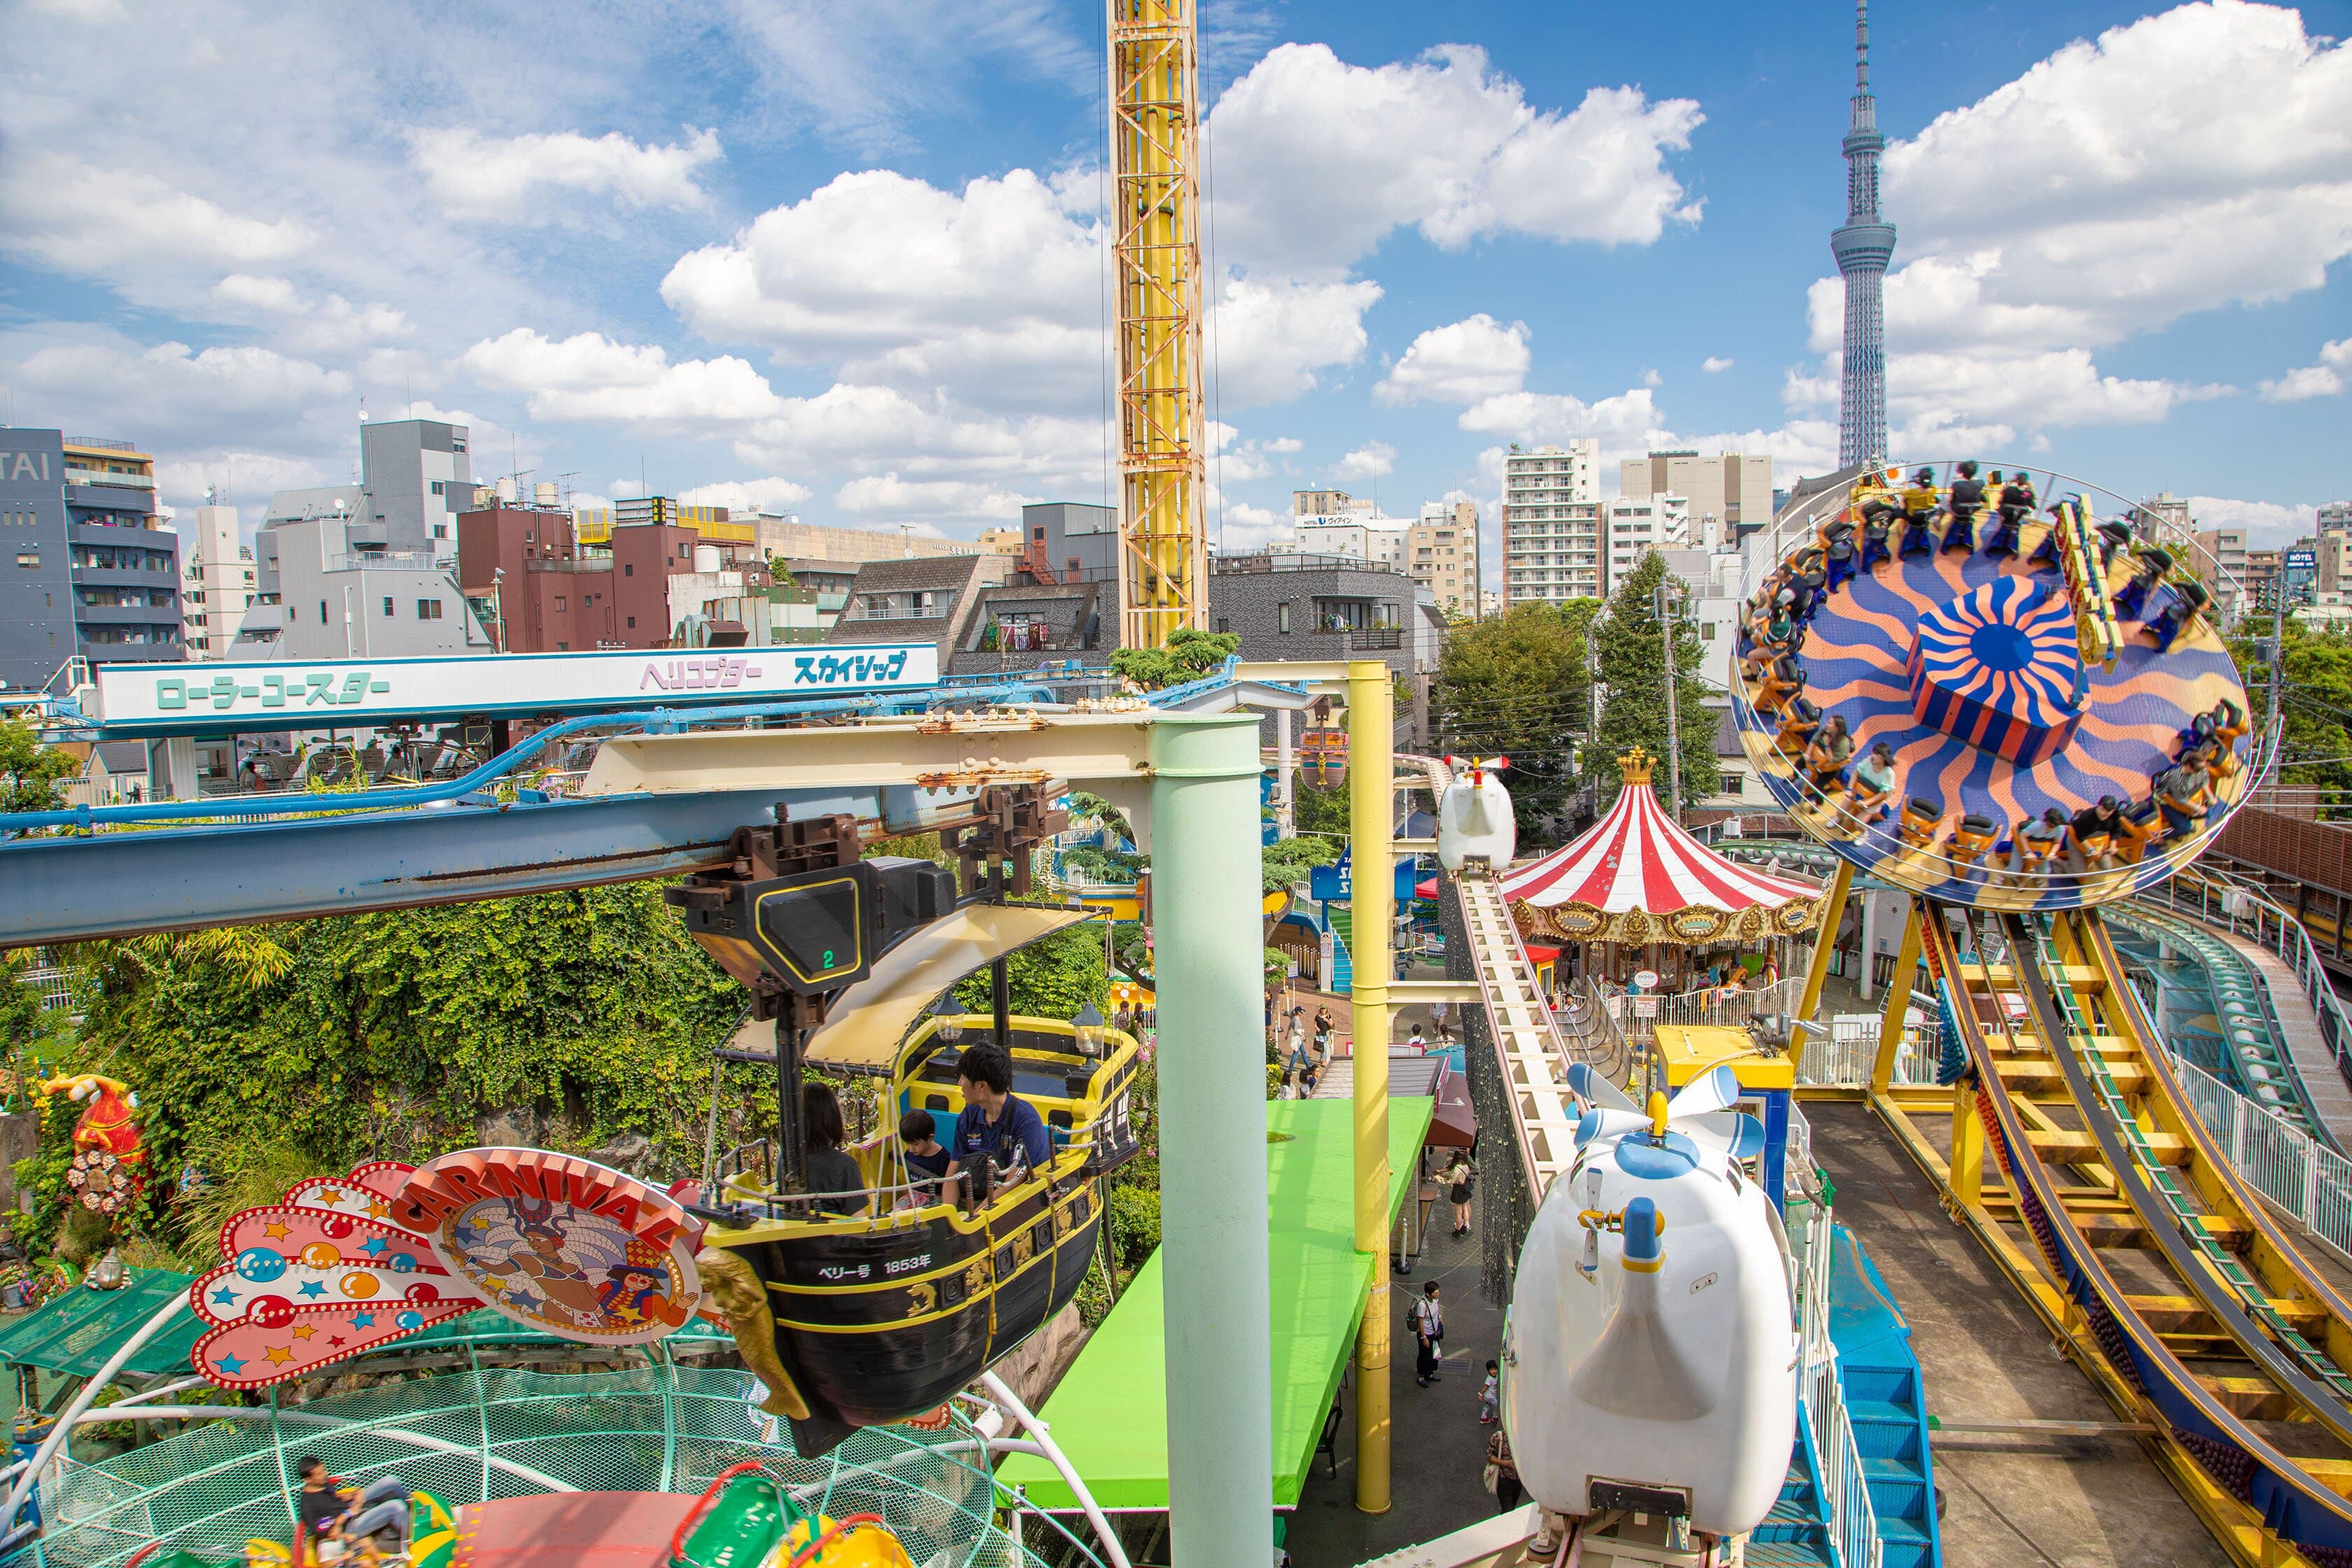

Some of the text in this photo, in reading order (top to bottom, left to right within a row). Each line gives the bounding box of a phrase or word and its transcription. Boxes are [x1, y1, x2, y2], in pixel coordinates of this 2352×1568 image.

[640, 650, 907, 689] ヘリコプター スカイシップ
[157, 672, 390, 709] ローラーコースター
[823, 950, 834, 969] 2
[389, 1152, 685, 1252] CARNIVAL
[884, 1254, 931, 1274] 1853年
